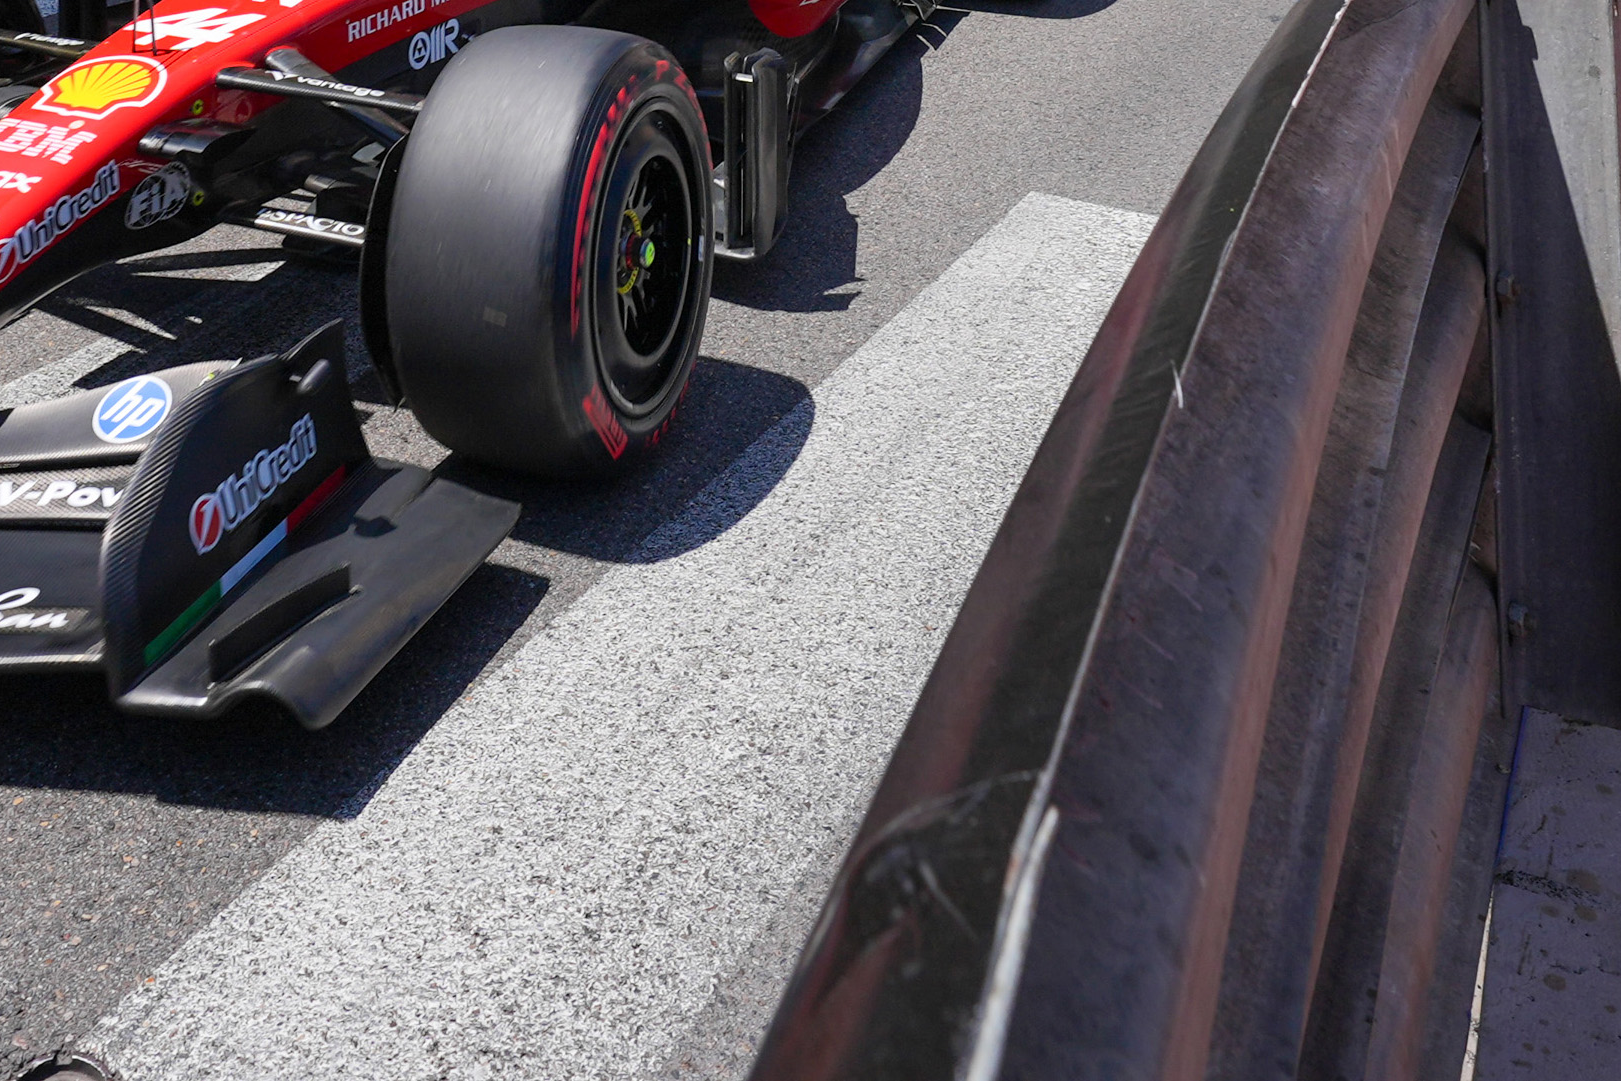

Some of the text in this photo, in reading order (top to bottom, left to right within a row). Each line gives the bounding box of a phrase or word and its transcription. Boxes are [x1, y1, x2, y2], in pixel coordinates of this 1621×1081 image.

[297, 76, 386, 97] vantage
[15, 159, 121, 264] UniCredit
[93, 375, 173, 443] hp
[218, 413, 317, 531] UniCredit
